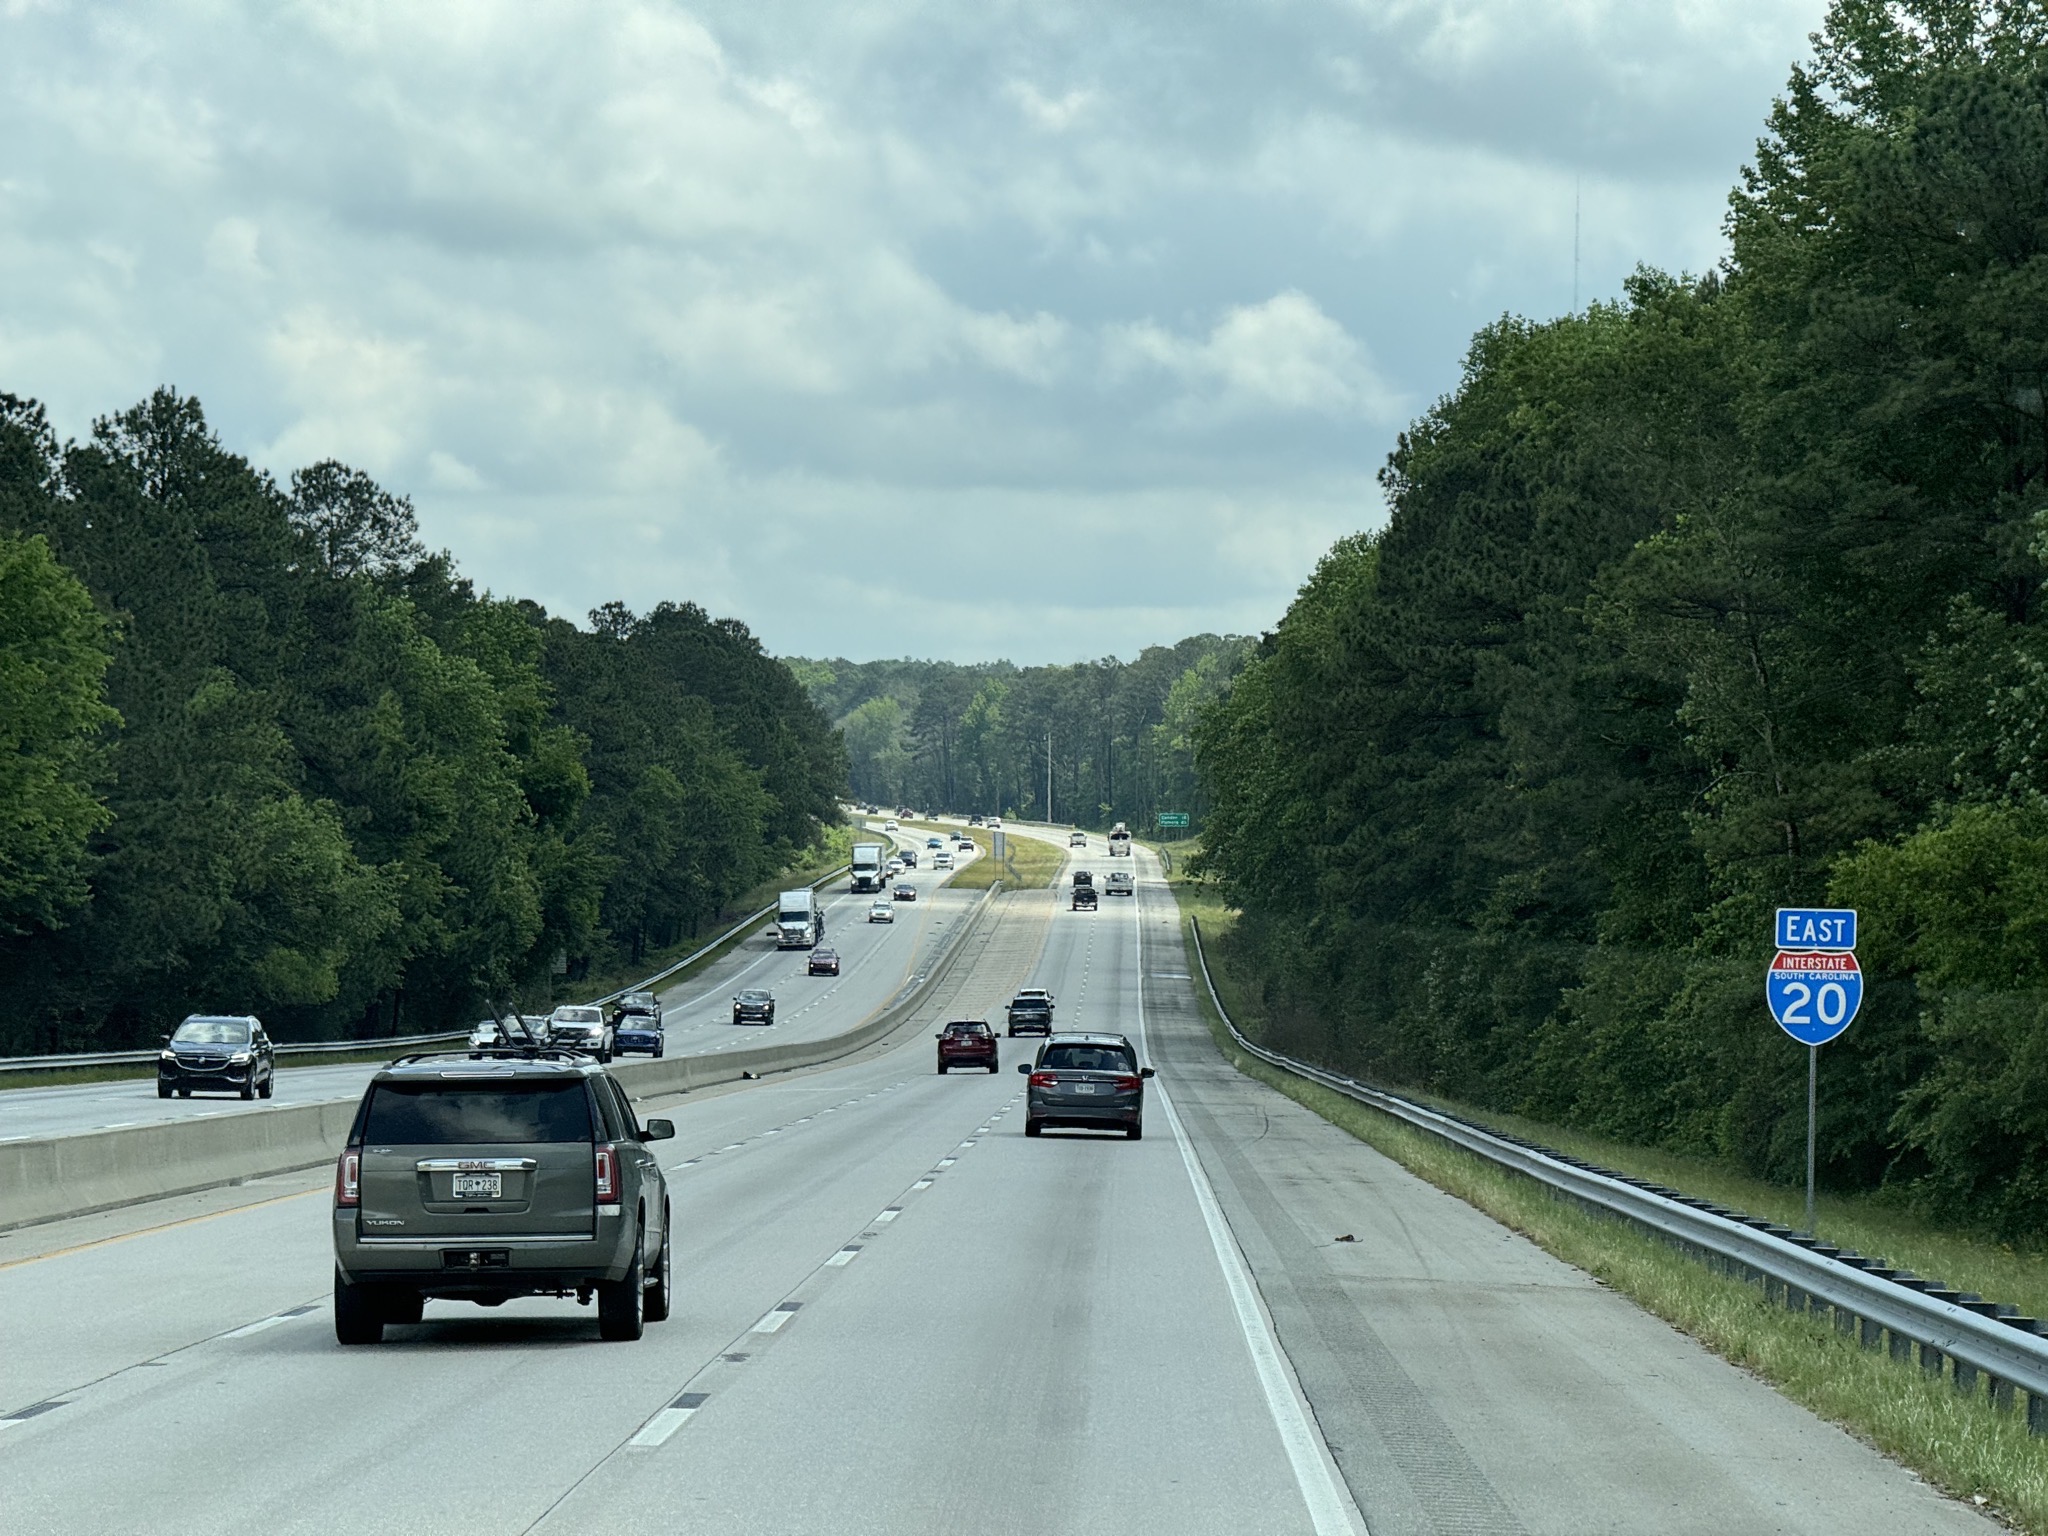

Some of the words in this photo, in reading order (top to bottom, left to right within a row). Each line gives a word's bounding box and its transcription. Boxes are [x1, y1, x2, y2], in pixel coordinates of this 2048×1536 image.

[1786, 916, 1847, 942] EAST
[1782, 957, 1848, 970] INTERSTATE
[1774, 971, 1805, 980] SOUTH
[1808, 972, 1855, 981] CAROLINA
[1781, 981, 1847, 1025] 20
[457, 1161, 496, 1170] GMC
[481, 1179, 498, 1191] 238
